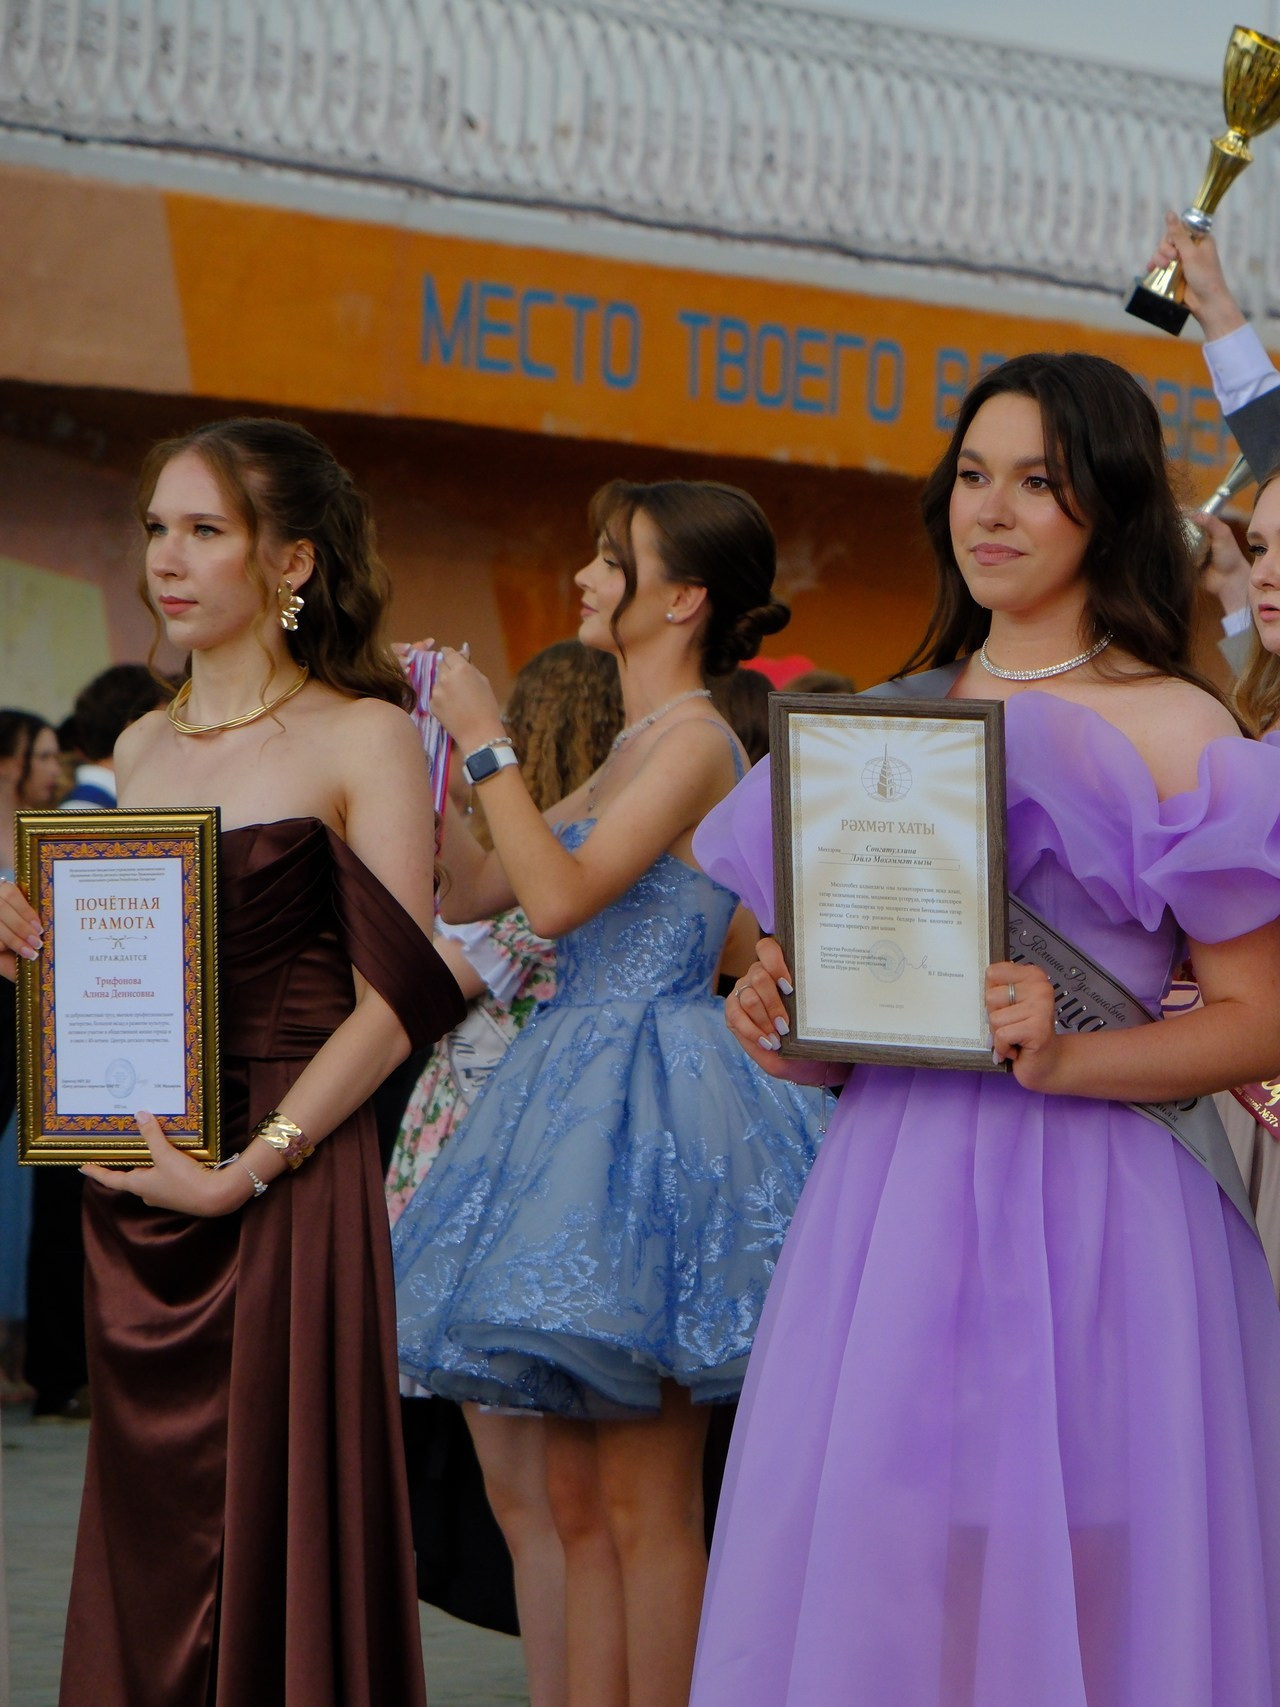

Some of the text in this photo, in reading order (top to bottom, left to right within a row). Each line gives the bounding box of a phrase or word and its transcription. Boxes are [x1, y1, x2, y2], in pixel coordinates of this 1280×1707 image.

[421, 272, 641, 390] МЕСТО
[678, 310, 905, 424] ТВОЕГО
[840, 819, 935, 836] РӘХМӘТ ХАТЫ
[75, 895, 161, 911] ПОЧЁТНАЯ
[80, 916, 156, 930] ГРАМОТА
[89, 954, 148, 962] НАГРАЖДАЕТСЯ
[95, 976, 142, 988] Трифонова
[82, 989, 155, 999] Алина Денисовна
